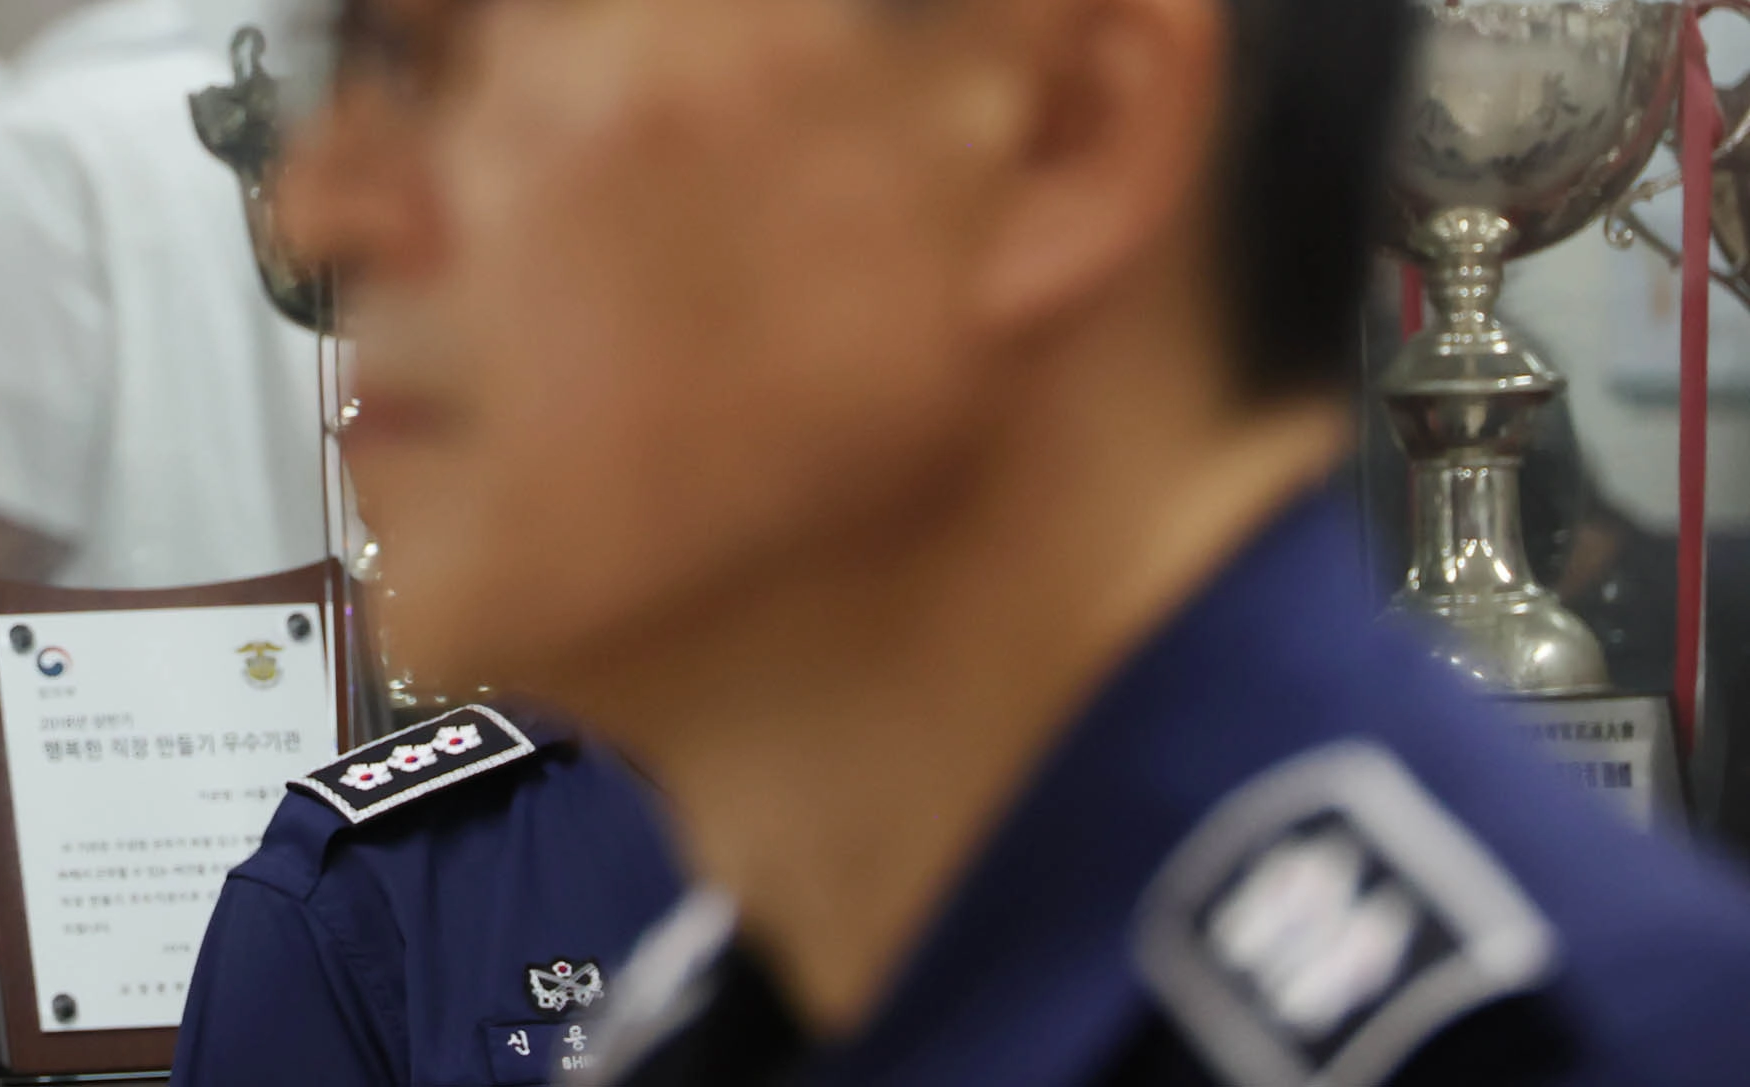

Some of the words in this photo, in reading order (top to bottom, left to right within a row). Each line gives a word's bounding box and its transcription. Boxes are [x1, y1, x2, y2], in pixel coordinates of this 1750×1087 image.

[42, 738, 104, 762] 행복한
[111, 735, 149, 760] 직장
[156, 733, 216, 759] 만들기
[223, 729, 302, 755] 우수기관
[507, 1029, 531, 1056] 신
[563, 1024, 588, 1051] 용
